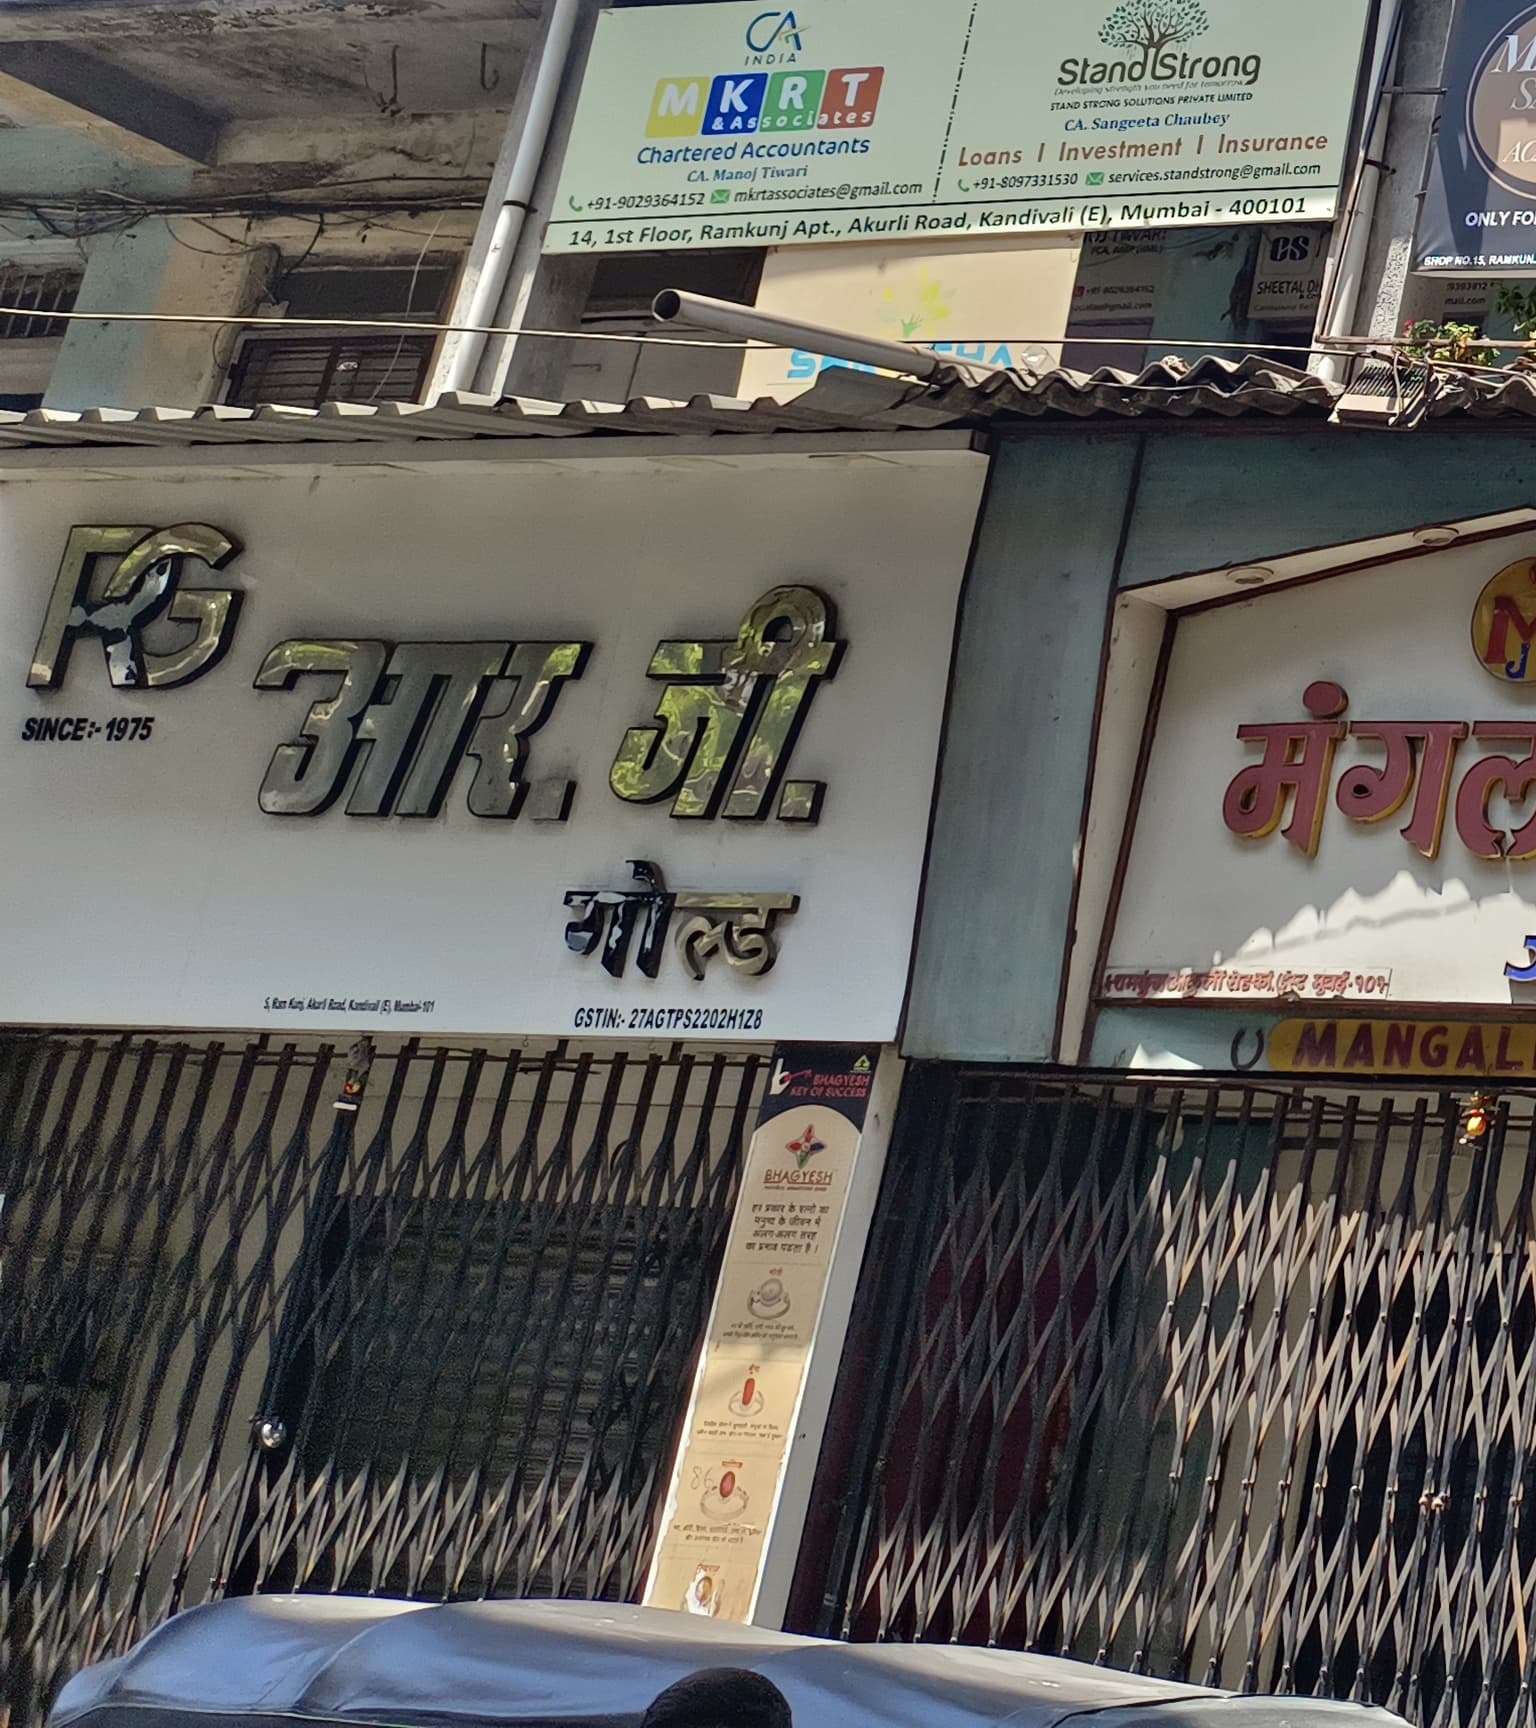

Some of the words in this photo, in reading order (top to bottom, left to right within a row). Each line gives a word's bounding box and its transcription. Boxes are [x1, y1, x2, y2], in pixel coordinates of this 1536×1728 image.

[744, 53, 797, 66] INDIA
[1050, 101, 1080, 111] STAND
[1083, 99, 1120, 109] STRONG
[1124, 96, 1175, 107] SOLUTIONS
[1177, 94, 1215, 104] PRIVATE
[1217, 92, 1253, 102] LIMITED
[1064, 117, 1088, 132] CA.
[637, 141, 737, 165] Chartered
[740, 137, 870, 160] Accountants
[958, 147, 1022, 167] Loans
[1059, 137, 1183, 162] Investment
[1218, 133, 1329, 155] Insurance
[712, 168, 758, 183] Manoj
[762, 165, 809, 179] Tiwari
[1108, 162, 1321, 184] services.standstrong@gmail.com
[587, 193, 704, 209] +91-9029364152
[734, 182, 922, 203] mkrtassociates@gmail.com
[569, 229, 598, 248] 14,
[604, 227, 635, 245] 1st
[639, 223, 694, 244] Floor,
[700, 220, 787, 243] Ramkunj
[794, 218, 842, 238] Apt.,
[848, 215, 909, 234] Akurli
[915, 211, 972, 232] Road,
[979, 206, 1076, 227] Kandivali
[1080, 204, 1113, 227] (E),
[1121, 200, 1210, 221] Mumbai
[1229, 197, 1306, 217] 400101
[1465, 210, 1510, 227] ONLY
[1424, 255, 1454, 266] SHOP
[1256, 280, 1304, 295] SHEETAL
[106, 717, 154, 741] 1975
[563, 858, 800, 980] गोल्ड
[813, 1074, 869, 1087] BHAGYESH
[791, 1087, 808, 1097] KEY
[810, 1087, 824, 1097] OF
[825, 1087, 867, 1097] SUCCESS
[763, 1169, 832, 1185] BHAGYESH
